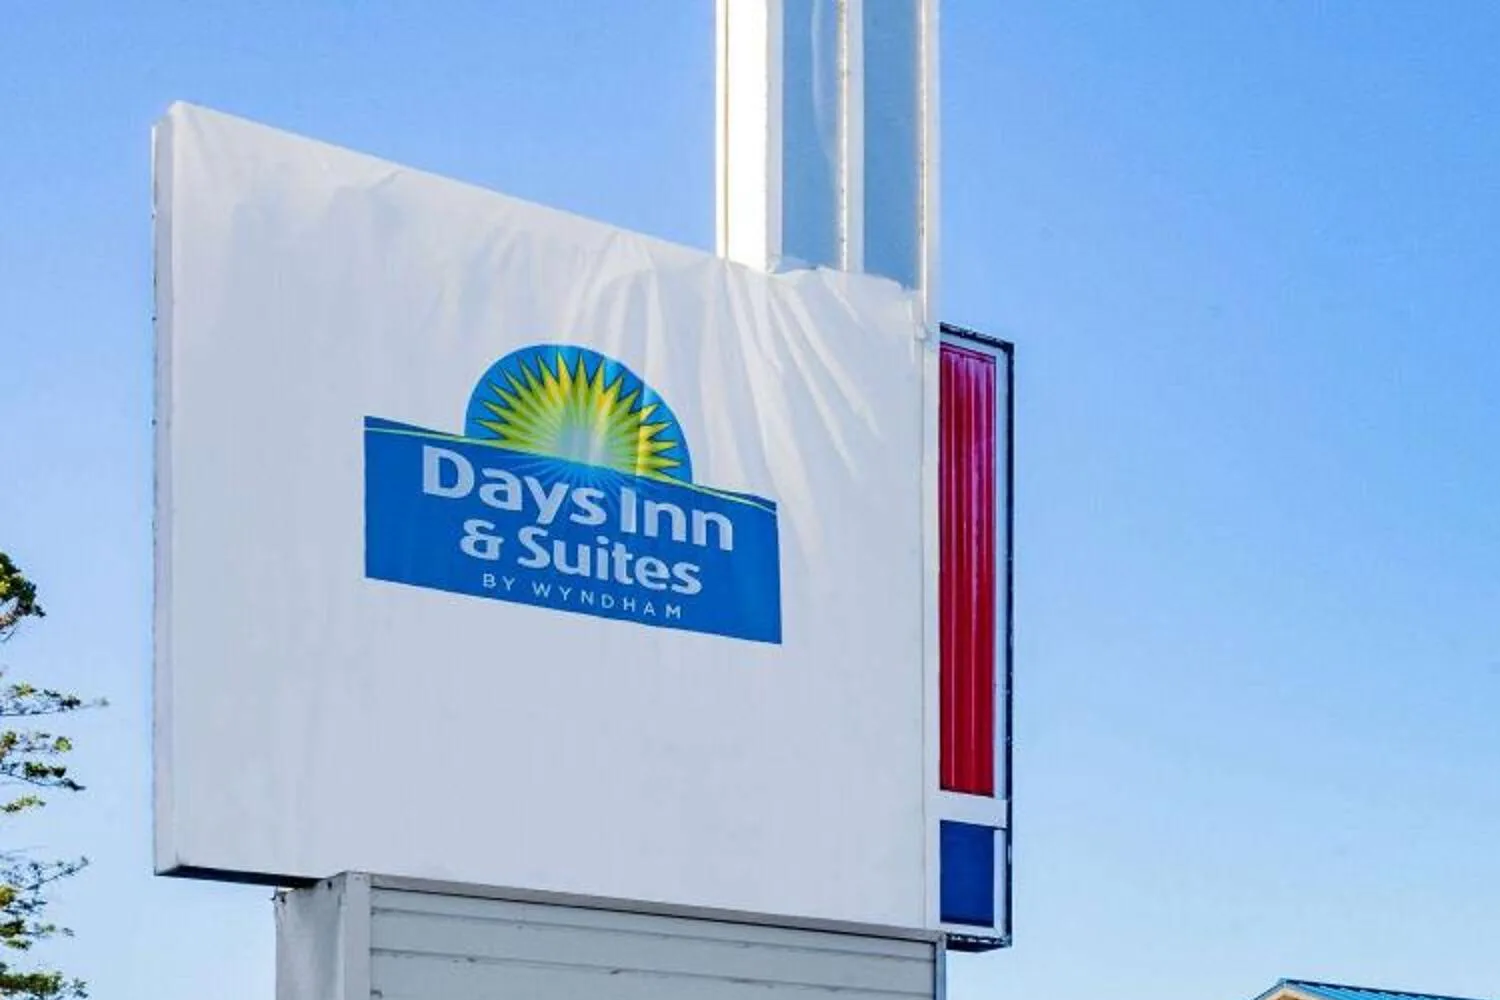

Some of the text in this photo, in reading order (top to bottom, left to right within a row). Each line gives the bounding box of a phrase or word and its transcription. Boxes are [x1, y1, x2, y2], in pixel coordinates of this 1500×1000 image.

[422, 445, 733, 551] Days Inn
[460, 518, 703, 596] & Suites
[483, 574, 682, 620] BY WYNDHAM
